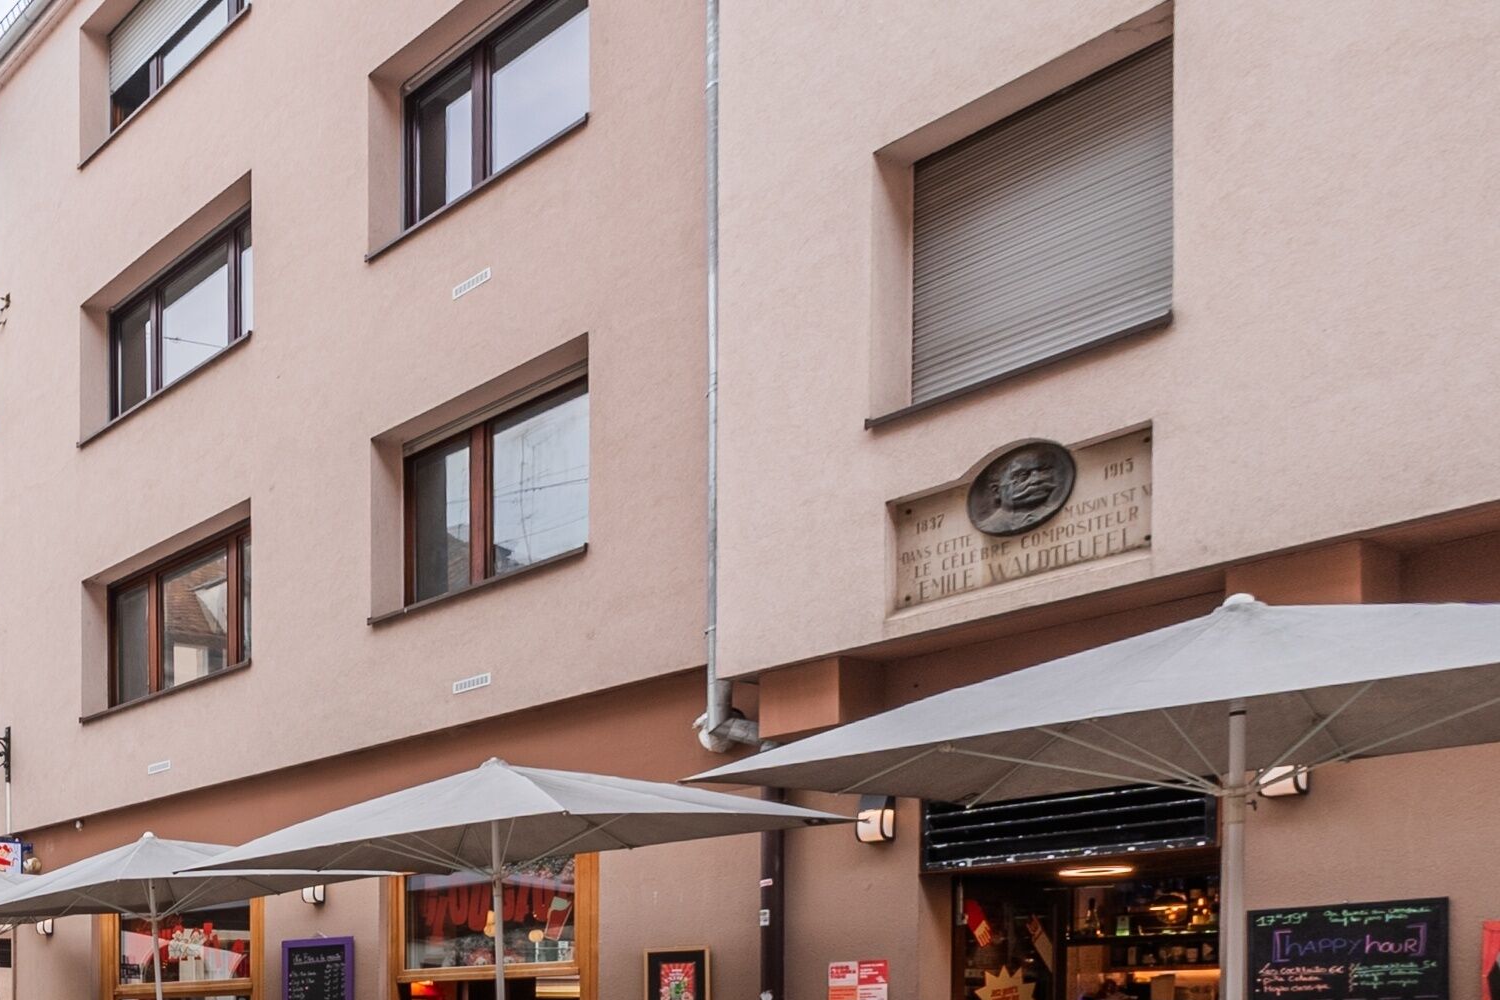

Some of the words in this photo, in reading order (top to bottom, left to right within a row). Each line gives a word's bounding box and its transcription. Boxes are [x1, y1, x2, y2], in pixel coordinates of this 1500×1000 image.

[901, 545, 932, 565] DANS
[937, 534, 972, 556] CETTE
[1064, 495, 1109, 518] MAISON
[1112, 487, 1137, 507] EST
[913, 513, 946, 535] 1837
[914, 561, 932, 579] LE
[1020, 504, 1139, 550] COMPOSITEUR
[987, 526, 1136, 583] WALDTEUFEL
